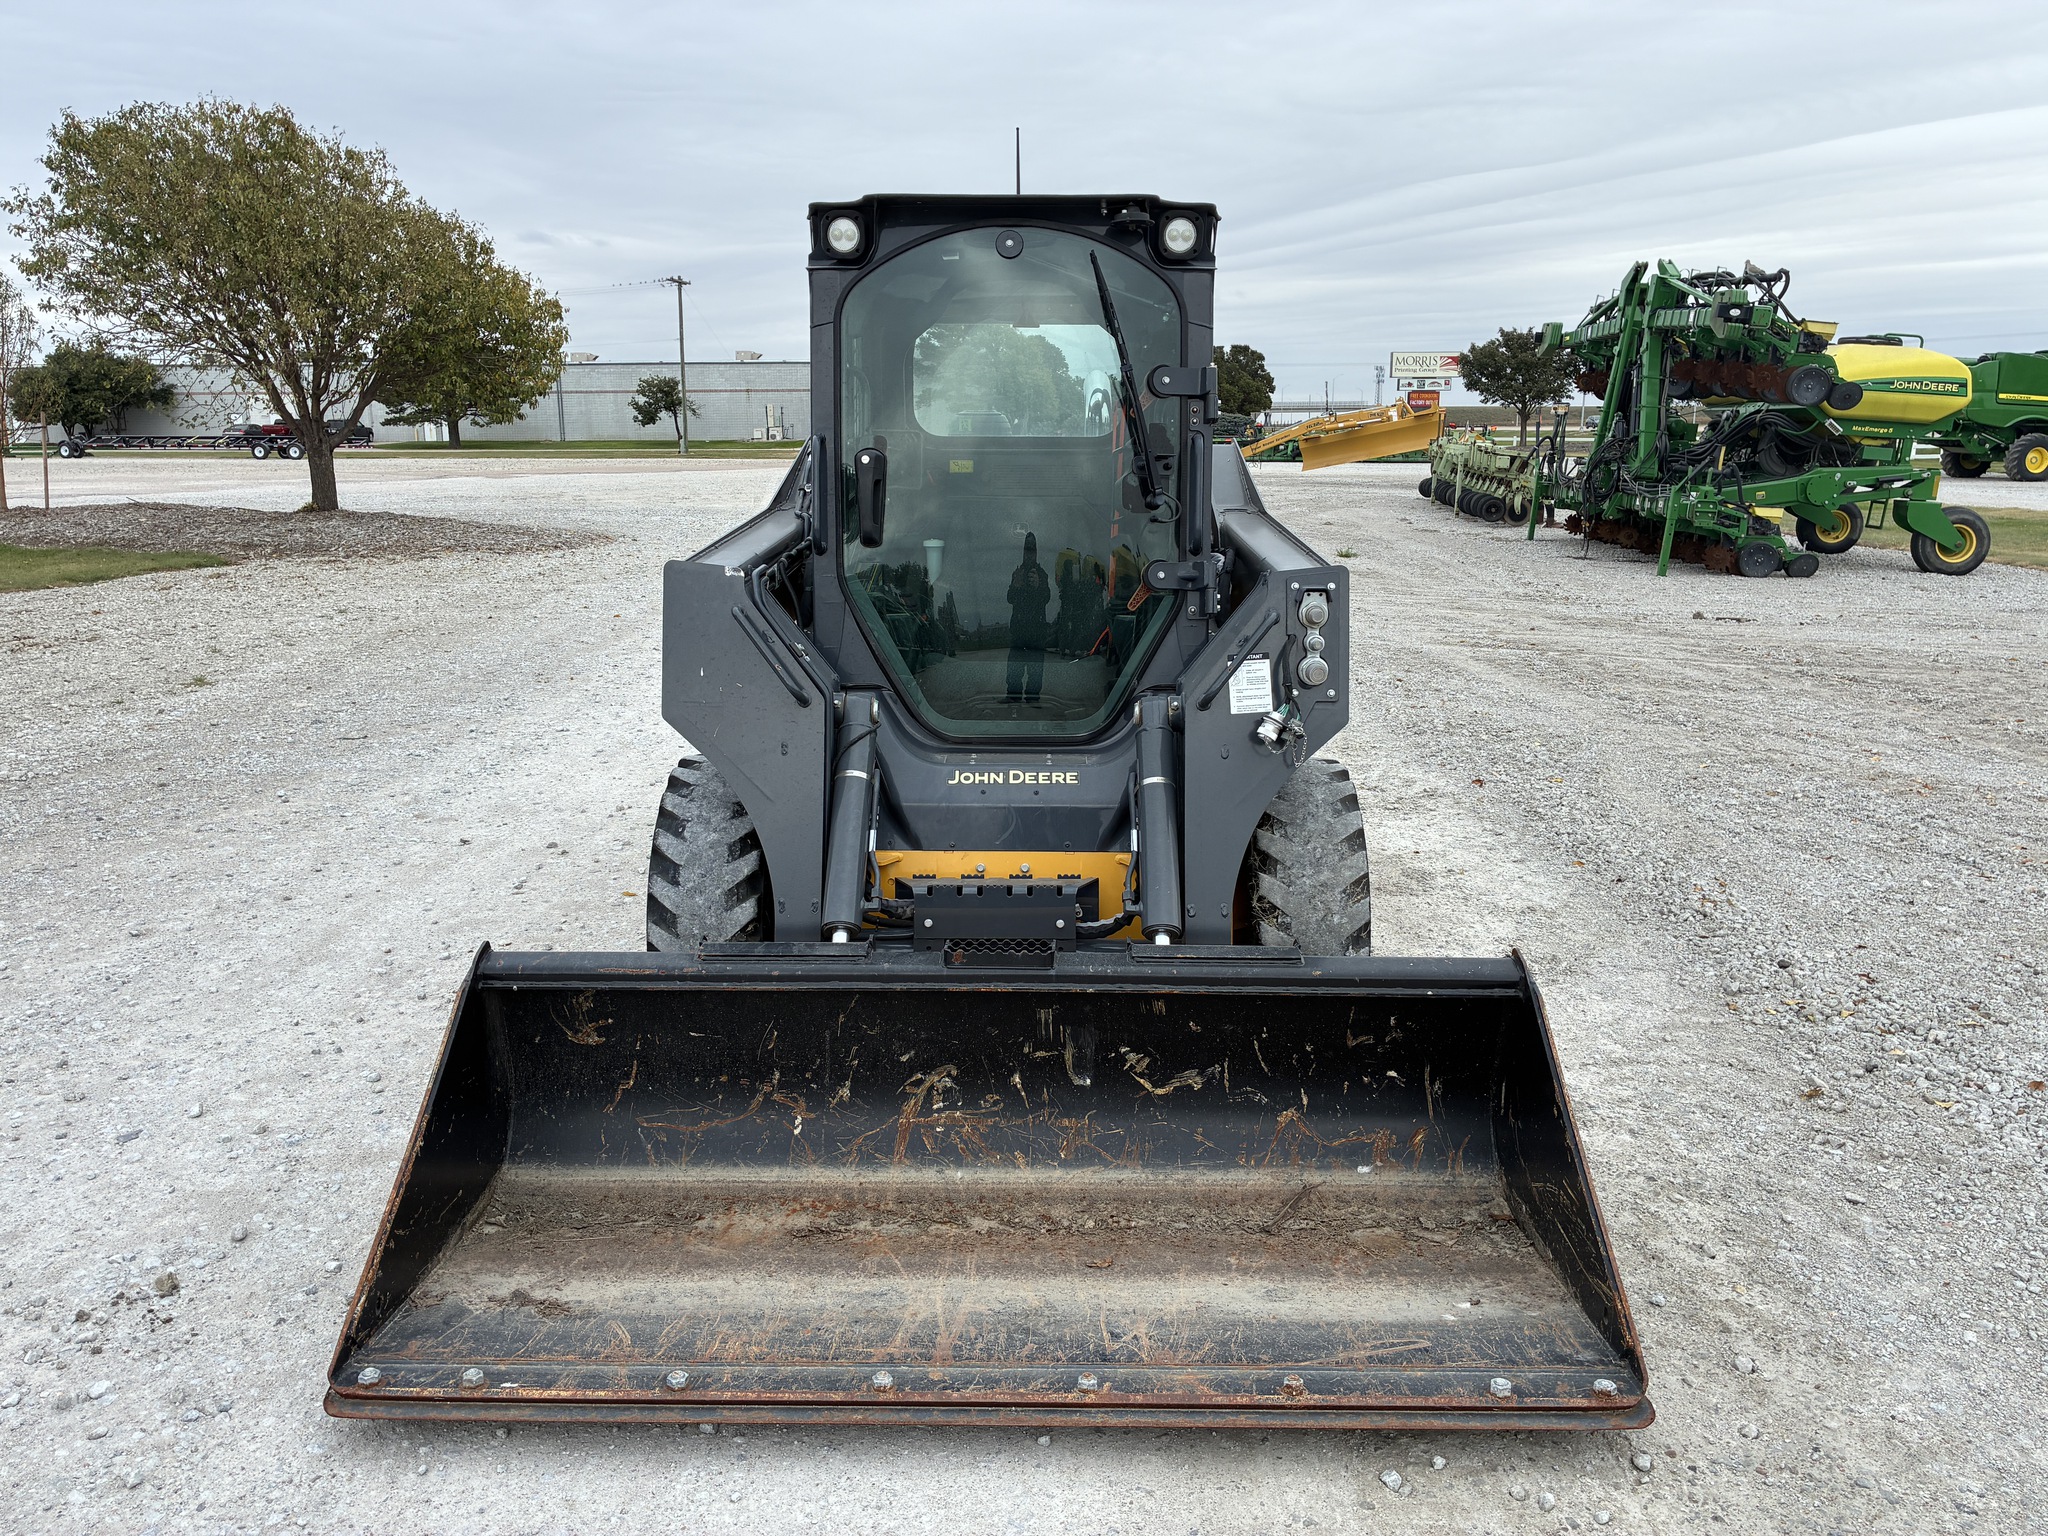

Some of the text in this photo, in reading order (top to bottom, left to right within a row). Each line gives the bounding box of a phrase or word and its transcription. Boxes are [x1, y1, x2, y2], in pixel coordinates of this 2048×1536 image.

[1395, 356, 1438, 367] MORRIS
[1890, 380, 1959, 392] JOHN DEERE
[948, 770, 1079, 785] JOHN DEERE
